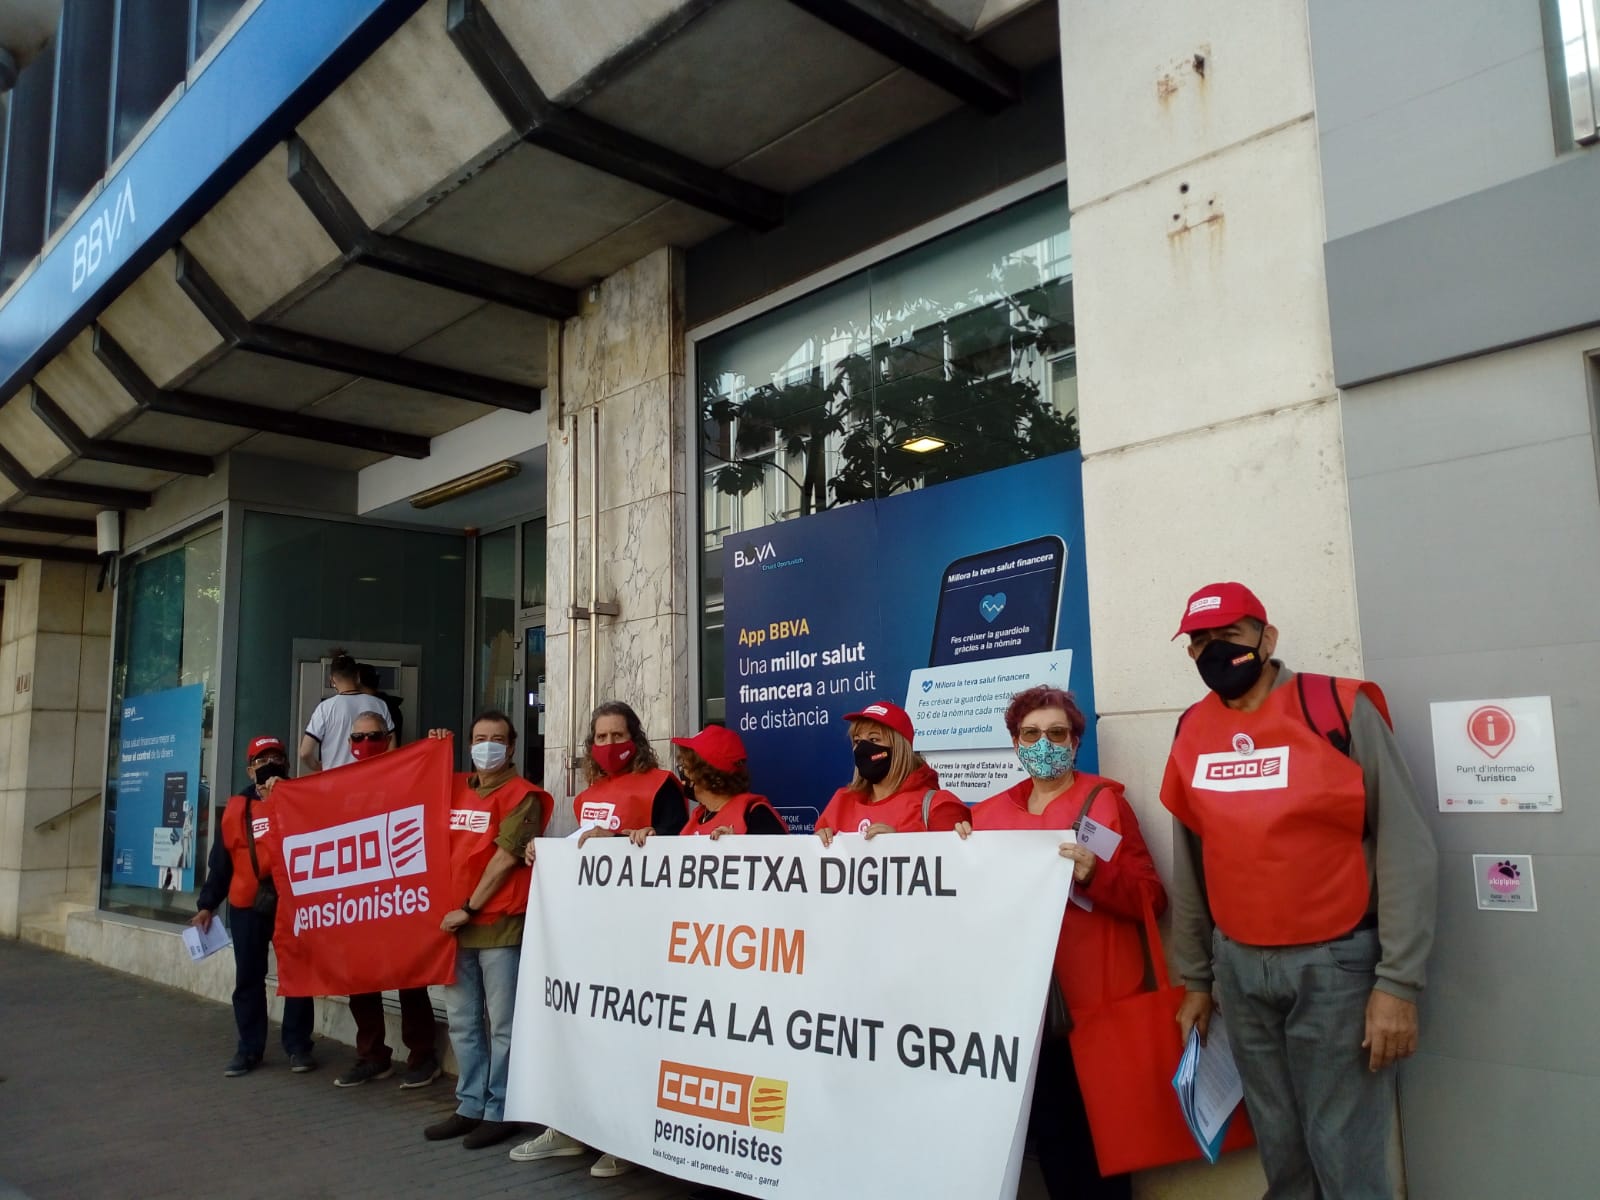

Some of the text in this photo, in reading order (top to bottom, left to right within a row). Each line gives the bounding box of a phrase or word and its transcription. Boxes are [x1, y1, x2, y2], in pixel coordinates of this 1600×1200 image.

[72, 177, 136, 293] BBVA
[948, 554, 1054, 583] Millora la teva salut financera
[739, 618, 809, 647] App BBVA
[950, 636, 962, 645] Fes
[987, 630, 994, 638] la
[995, 625, 1030, 640] guardiola
[986, 641, 993, 649] la
[994, 638, 1022, 648] nòmina
[739, 642, 866, 677] Una millor salut
[740, 671, 876, 704] financera a un dit
[934, 673, 1030, 689] Millora la teva salut financera
[918, 699, 930, 707] Fes
[954, 696, 960, 704] la
[960, 693, 993, 706] guardiola
[740, 706, 830, 731] de distància
[917, 711, 926, 720] 50
[926, 711, 932, 719] €
[932, 710, 941, 718] de
[941, 710, 948, 718] la
[948, 708, 974, 718] nòmina
[974, 707, 993, 716] cada
[950, 726, 957, 735] la
[958, 724, 993, 736] guardiola
[953, 772, 963, 780] per
[964, 771, 987, 779] millorar
[987, 771, 994, 779] la
[995, 771, 1008, 779] teva
[961, 762, 975, 770] regla
[976, 761, 1001, 769] d'Estalvi
[1210, 763, 1258, 778] CCOO
[1456, 764, 1535, 773] Punt d'Informació
[960, 780, 991, 789] financera?
[1476, 774, 1517, 783] Turística
[789, 815, 800, 823] QUE
[289, 831, 381, 883] CCOO
[578, 854, 957, 897] NO A LA BRETXA DIGITAL
[668, 921, 804, 975] EXIGIM
[545, 975, 1019, 1083] BON TRACTE A LA GENT GRAN
[662, 1071, 742, 1113] CCOO
[654, 1119, 783, 1166] pensionistes
[690, 1160, 700, 1169] alt
[700, 1162, 729, 1175] penedès
[735, 1170, 753, 1181] anoia
[758, 1176, 779, 1188] garraf
